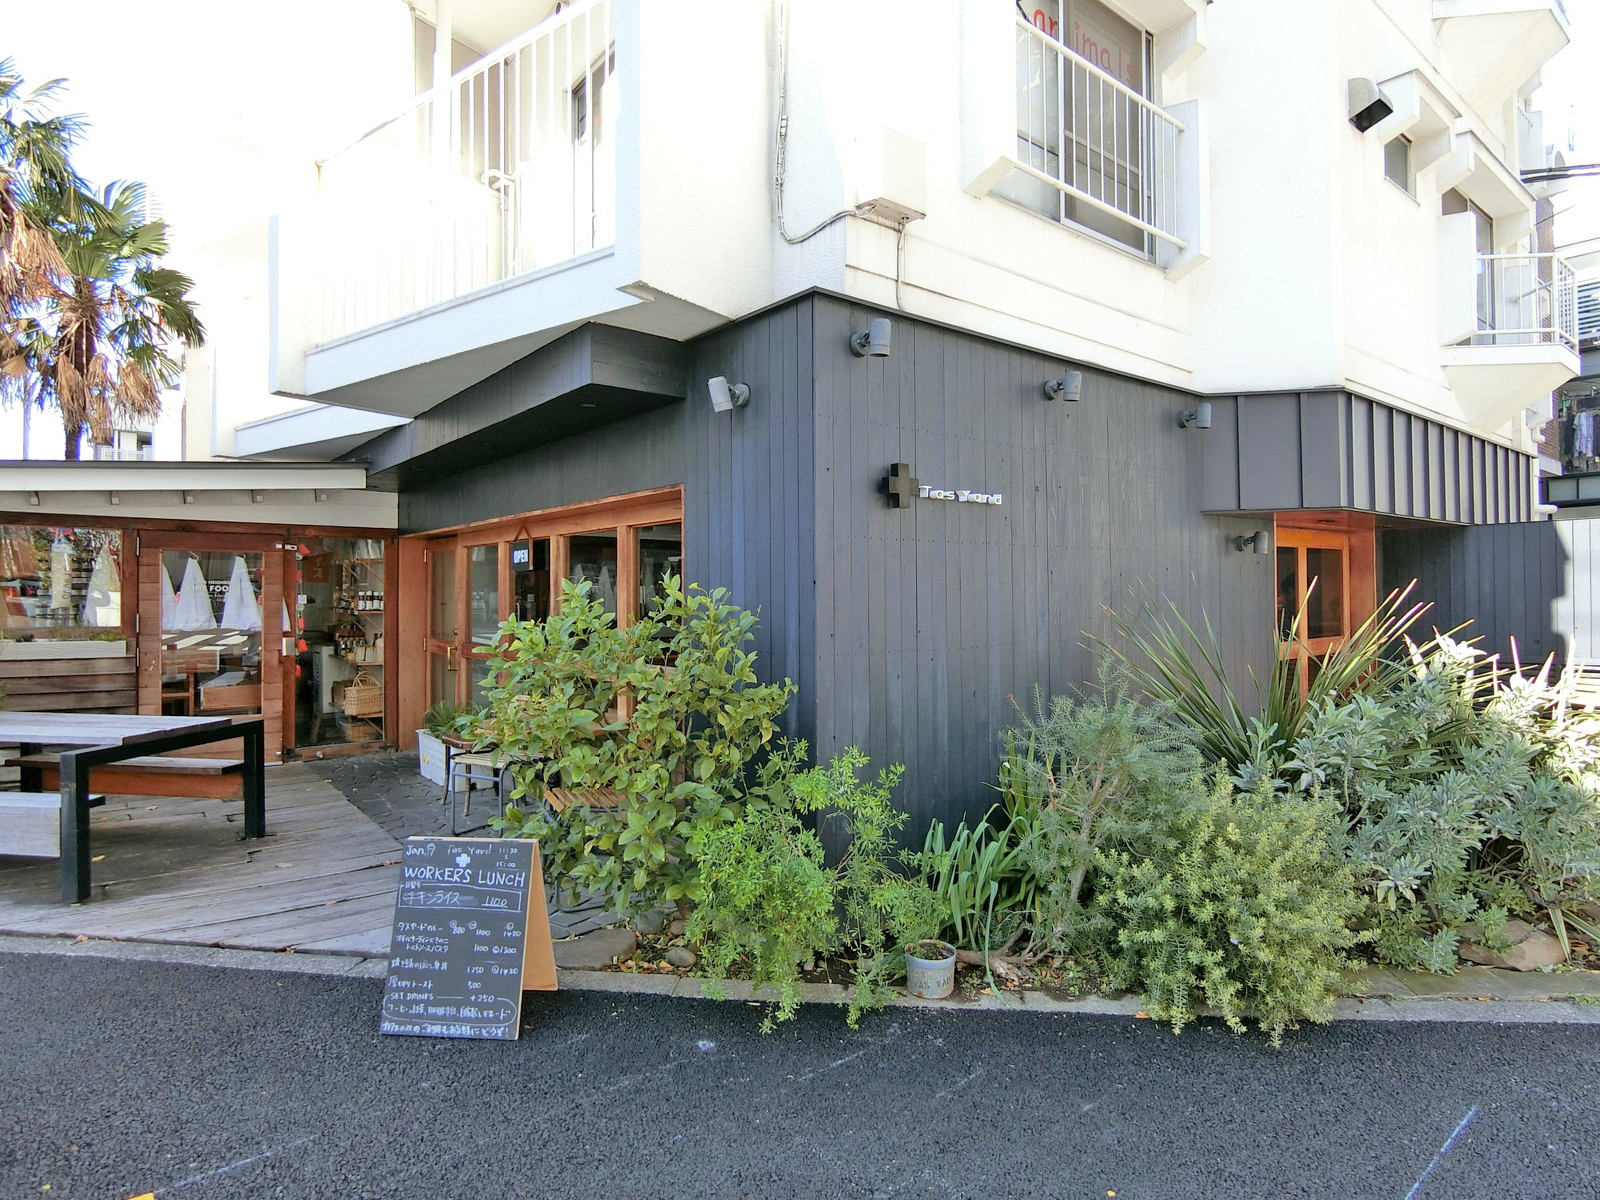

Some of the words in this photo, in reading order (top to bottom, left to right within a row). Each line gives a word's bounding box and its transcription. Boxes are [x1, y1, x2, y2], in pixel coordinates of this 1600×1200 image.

[918, 485, 955, 500] Tas
[956, 489, 1003, 505] Yard
[513, 549, 529, 564] OPEN
[404, 865, 472, 884] WORKERS
[478, 871, 526, 888] LUNCH
[402, 890, 462, 907] チキンライス
[390, 992, 404, 1001] SET
